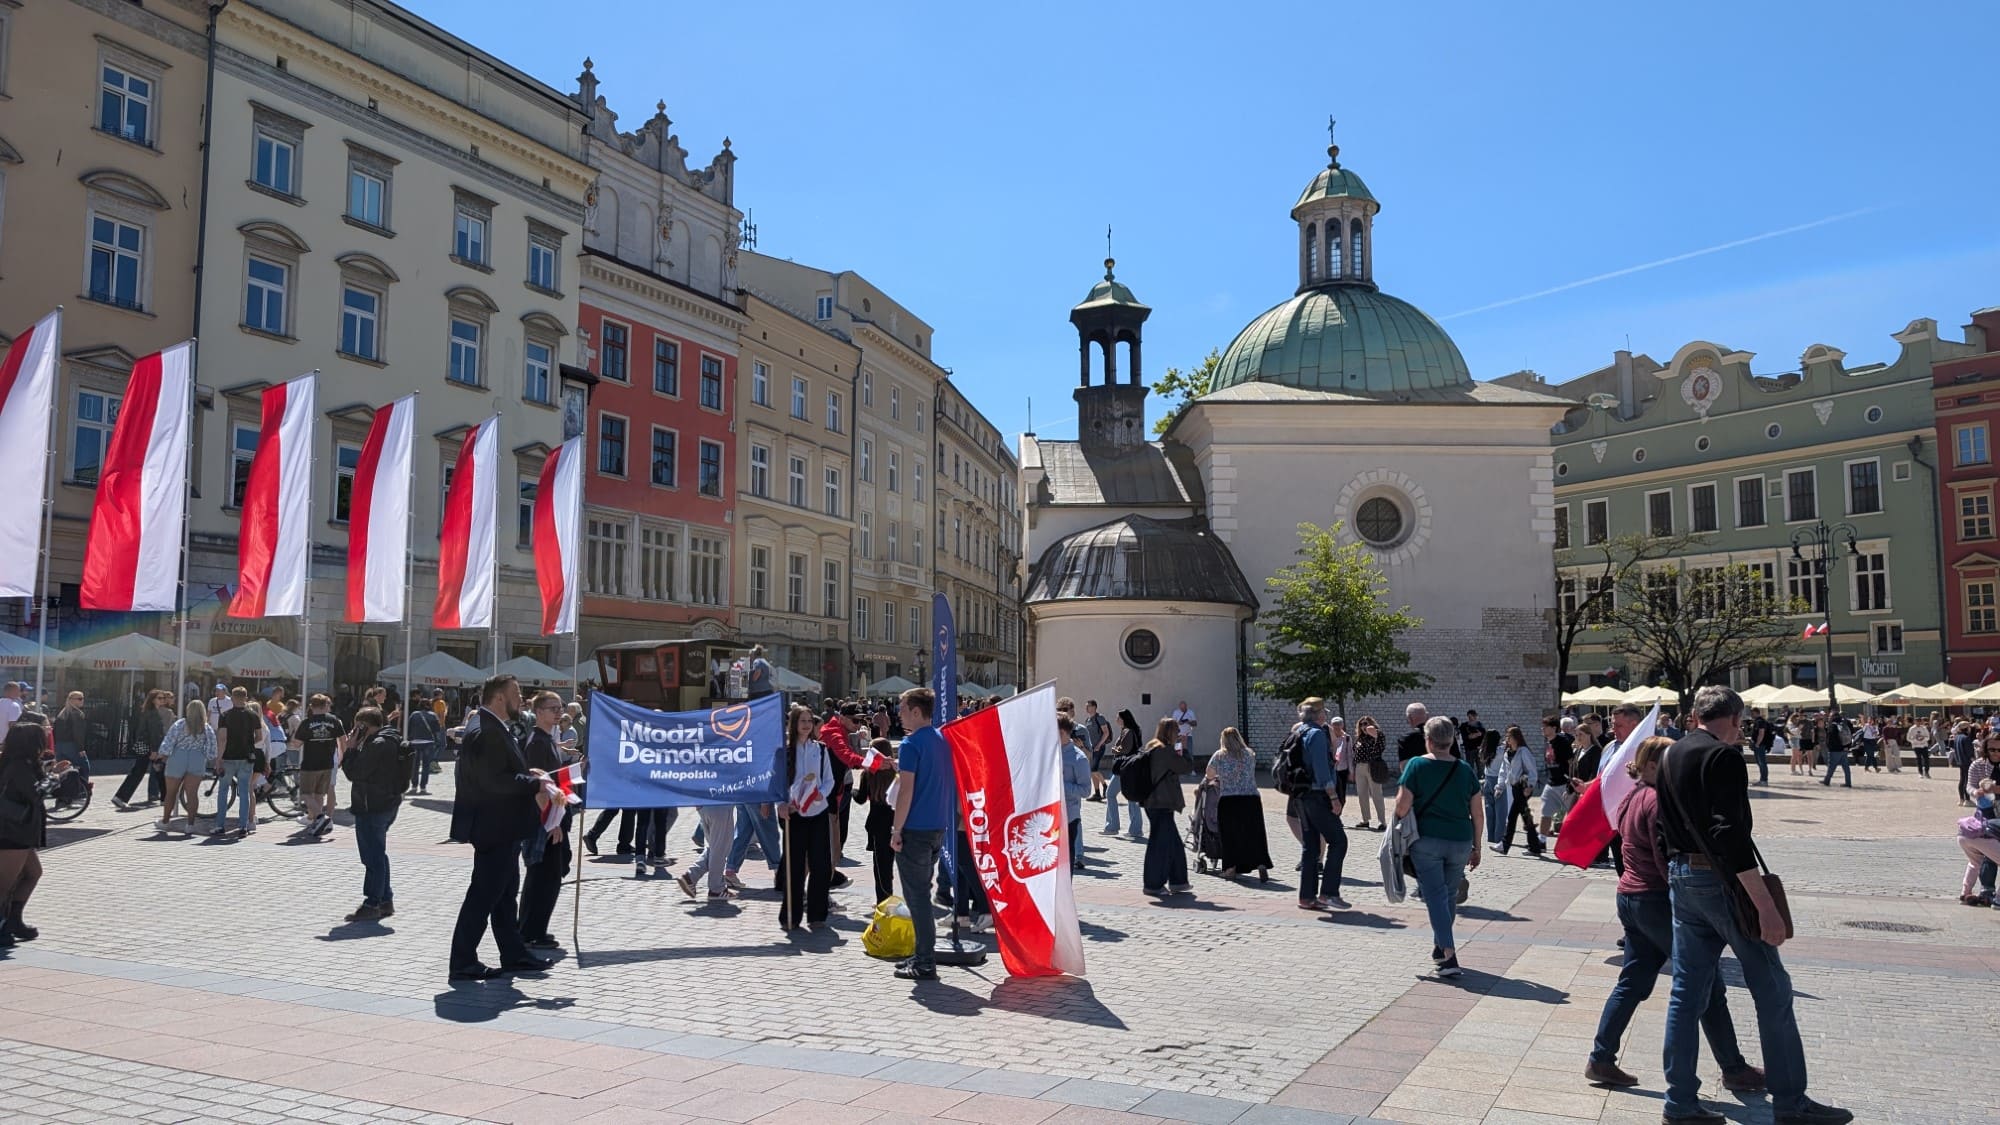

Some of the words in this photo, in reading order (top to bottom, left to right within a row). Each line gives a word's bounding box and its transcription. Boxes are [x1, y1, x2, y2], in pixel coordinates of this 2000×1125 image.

[620, 719, 704, 743] Młodzi
[618, 740, 753, 764] Demokraci
[650, 769, 717, 782] Małopolska
[746, 775, 757, 788] do
[965, 787, 1008, 913] POLSKA
